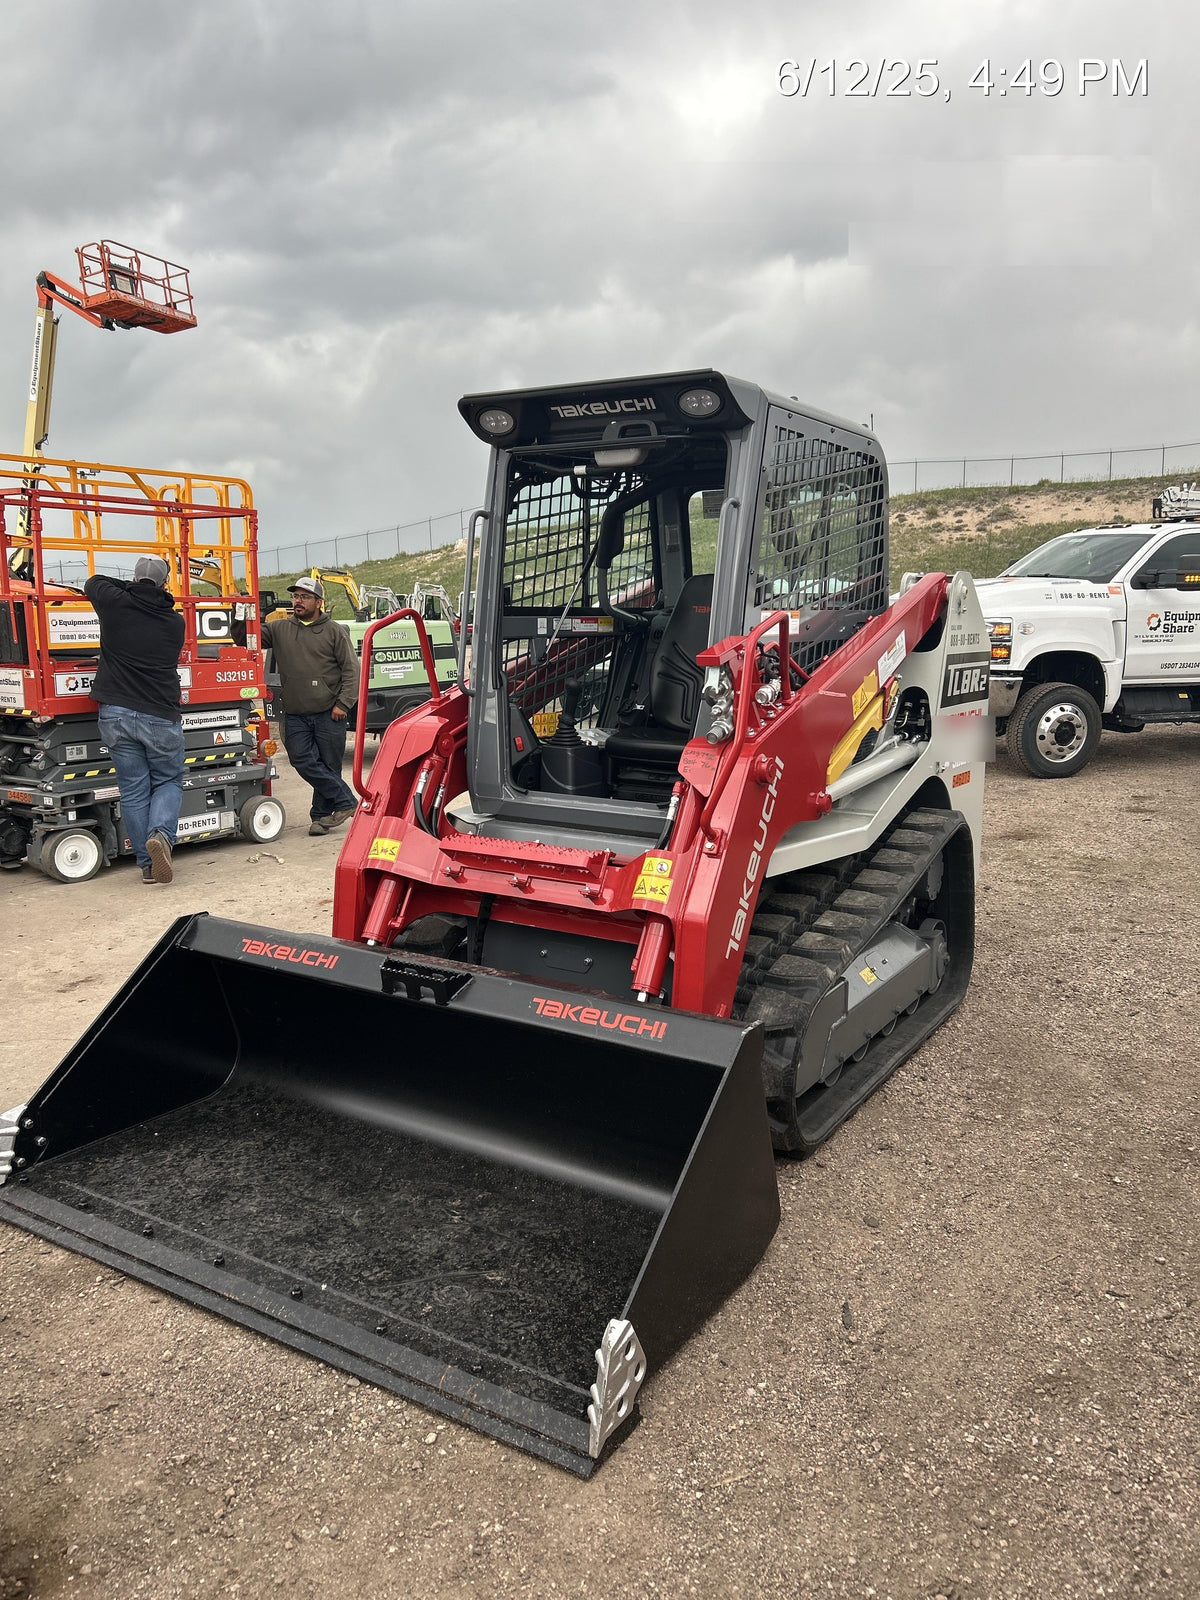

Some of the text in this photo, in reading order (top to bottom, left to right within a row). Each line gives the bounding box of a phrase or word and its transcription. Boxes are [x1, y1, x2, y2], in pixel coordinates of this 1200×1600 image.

[1163, 623, 1194, 633] Share
[386, 650, 421, 662] SULLAIR
[216, 670, 254, 682] SJ3219 E
[185, 715, 237, 725] EquipmentShare
